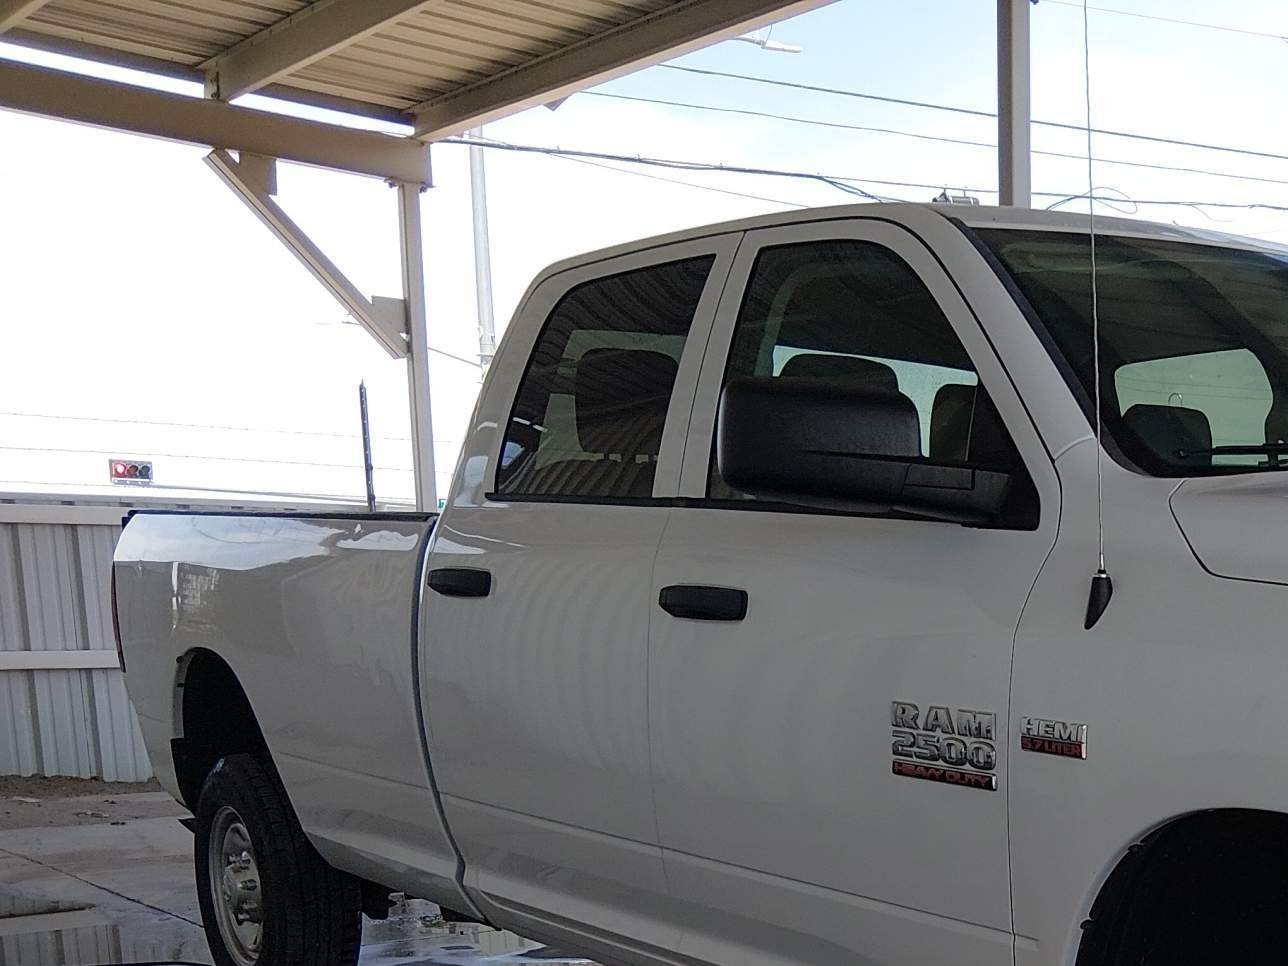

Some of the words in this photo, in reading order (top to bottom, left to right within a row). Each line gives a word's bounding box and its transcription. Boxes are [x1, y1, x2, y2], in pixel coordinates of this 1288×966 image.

[891, 701, 996, 740] RAM
[1020, 716, 1087, 744] HEMI
[892, 730, 996, 770] 2500
[1044, 741, 1081, 756] LITER
[894, 762, 944, 778] HEAVY
[946, 770, 990, 787] DUTY
